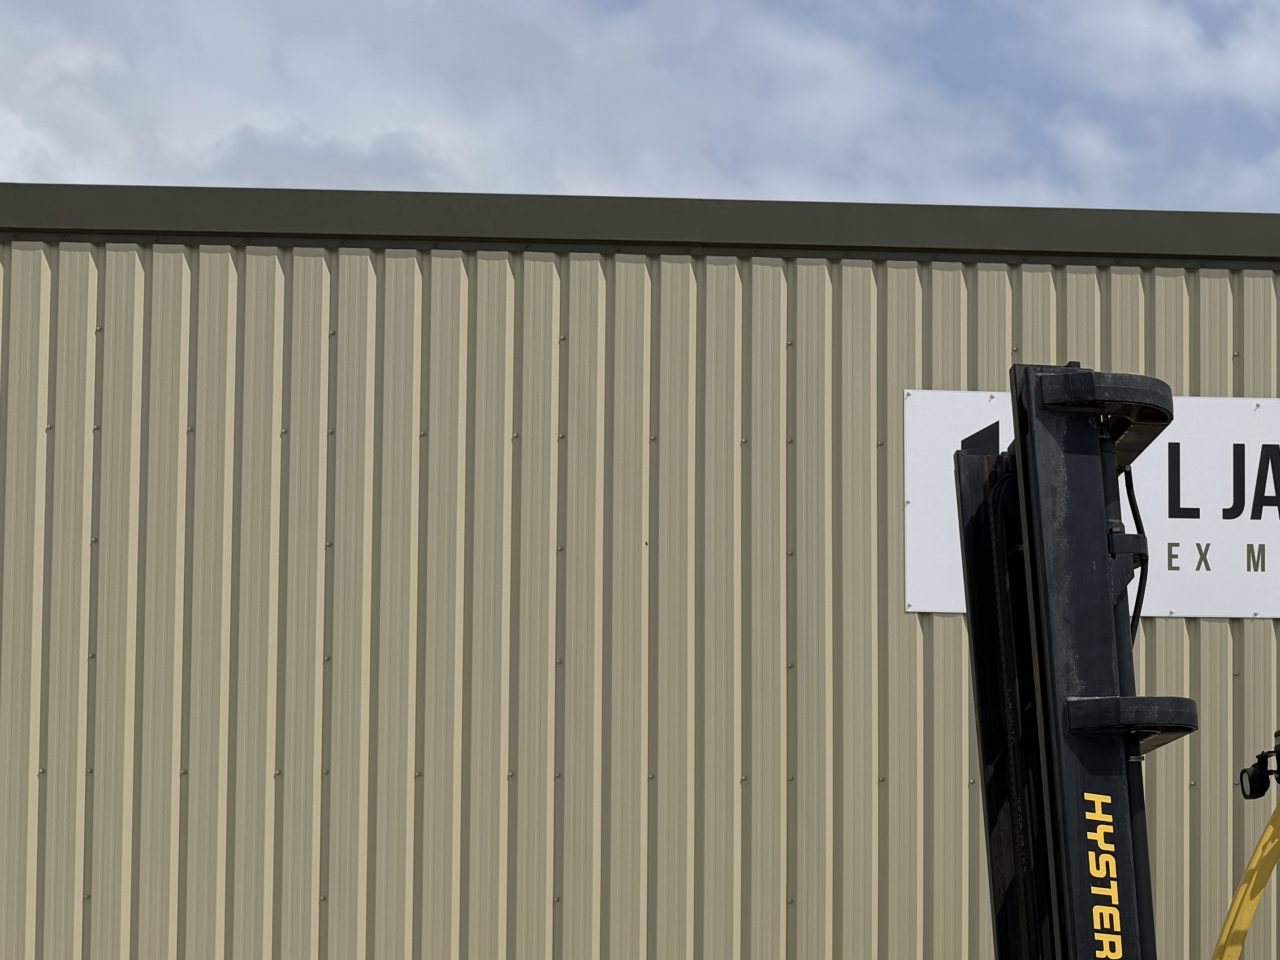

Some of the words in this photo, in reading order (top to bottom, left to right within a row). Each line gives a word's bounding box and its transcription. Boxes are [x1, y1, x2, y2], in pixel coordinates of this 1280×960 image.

[1167, 441, 1201, 520] L
[1167, 542, 1213, 572] EX
[1083, 791, 1123, 960] HYSTER
